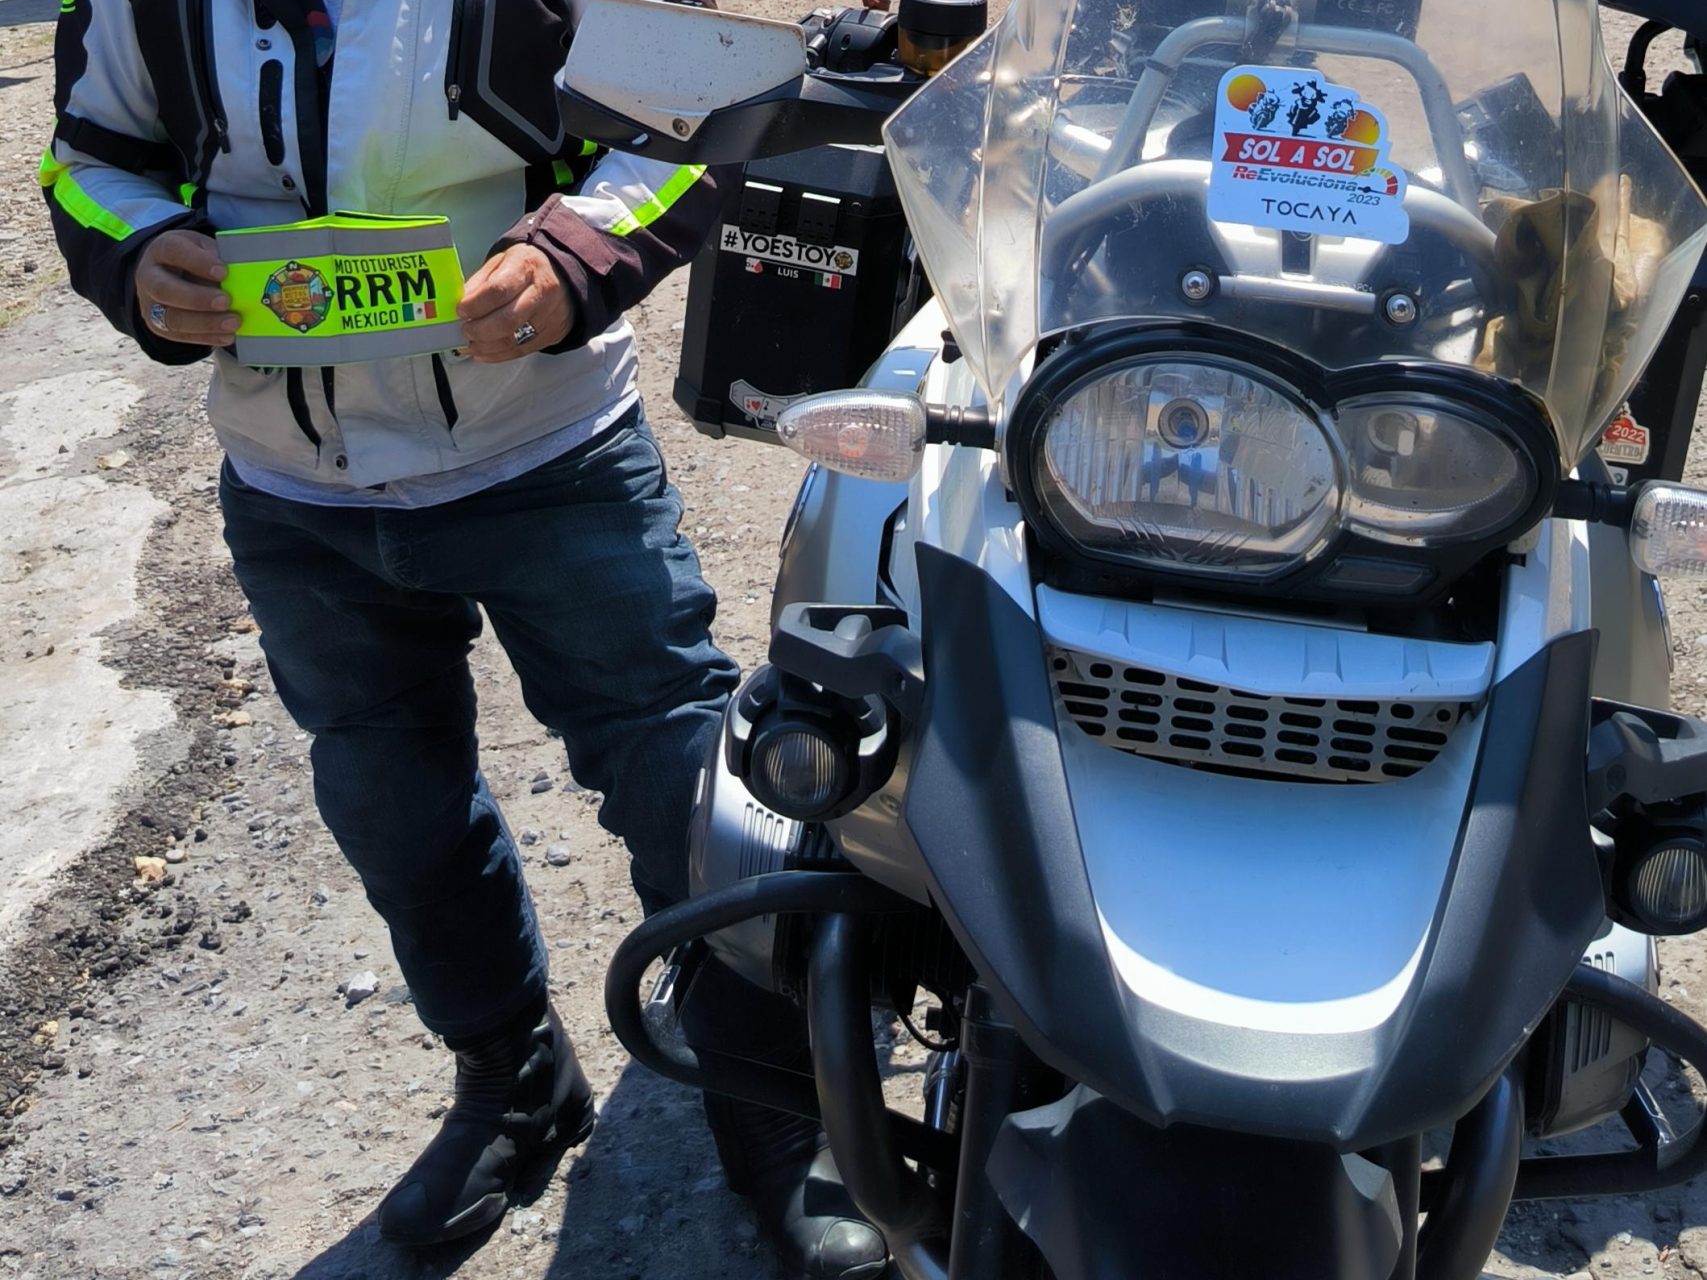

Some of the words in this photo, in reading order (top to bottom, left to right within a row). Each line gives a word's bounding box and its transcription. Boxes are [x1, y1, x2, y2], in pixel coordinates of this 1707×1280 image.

[1239, 138, 1281, 162] SOL
[1290, 148, 1306, 163] A
[1313, 148, 1355, 171] SOL
[1232, 165, 1359, 192] ReEvoluciona
[1261, 198, 1357, 225] TOCAYA
[1347, 192, 1381, 207] 2023
[723, 230, 837, 267] #YOESTOY
[334, 254, 428, 274] MOTOTURISTA
[777, 266, 799, 279] LUIS
[336, 268, 436, 312] RRM
[342, 309, 399, 330] MÉXICO
[1612, 424, 1645, 443] 2022
